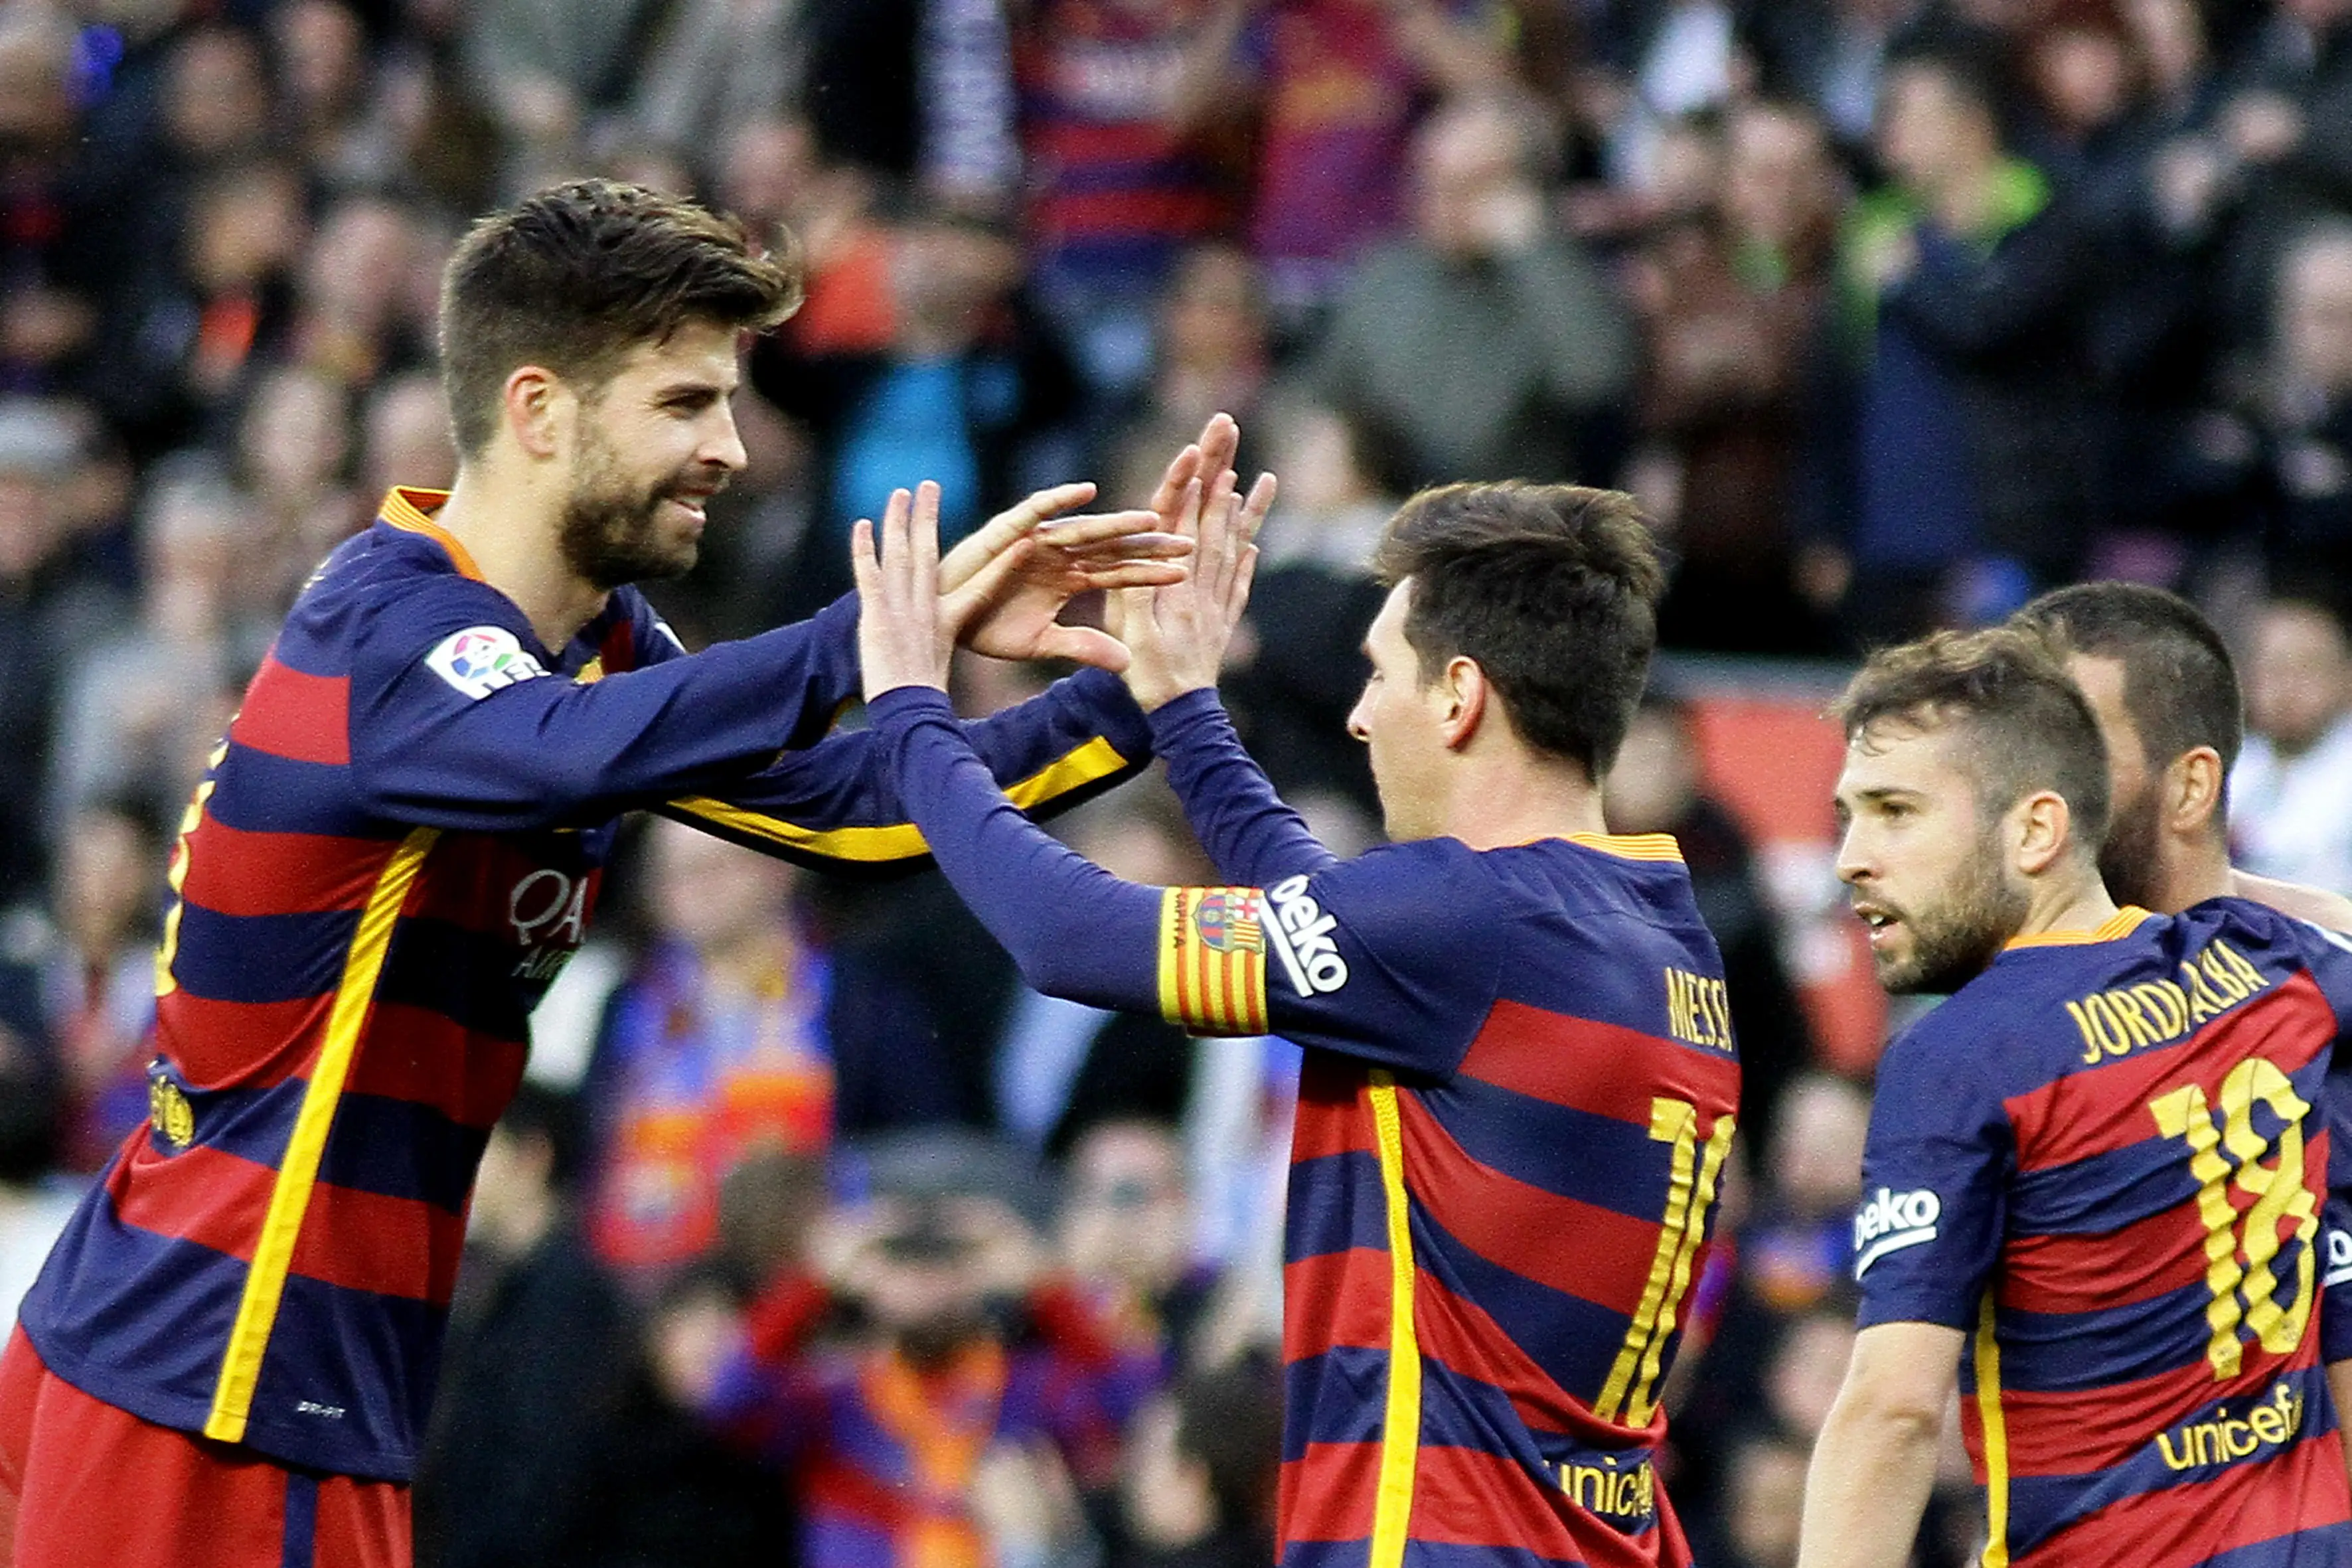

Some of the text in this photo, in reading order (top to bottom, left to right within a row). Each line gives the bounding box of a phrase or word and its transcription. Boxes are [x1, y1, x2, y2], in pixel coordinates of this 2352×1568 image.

[2065, 939, 2270, 1065] JORDI ALBA
[2148, 1058, 2319, 1381] 18
[2156, 1383, 2293, 1470] unicef
